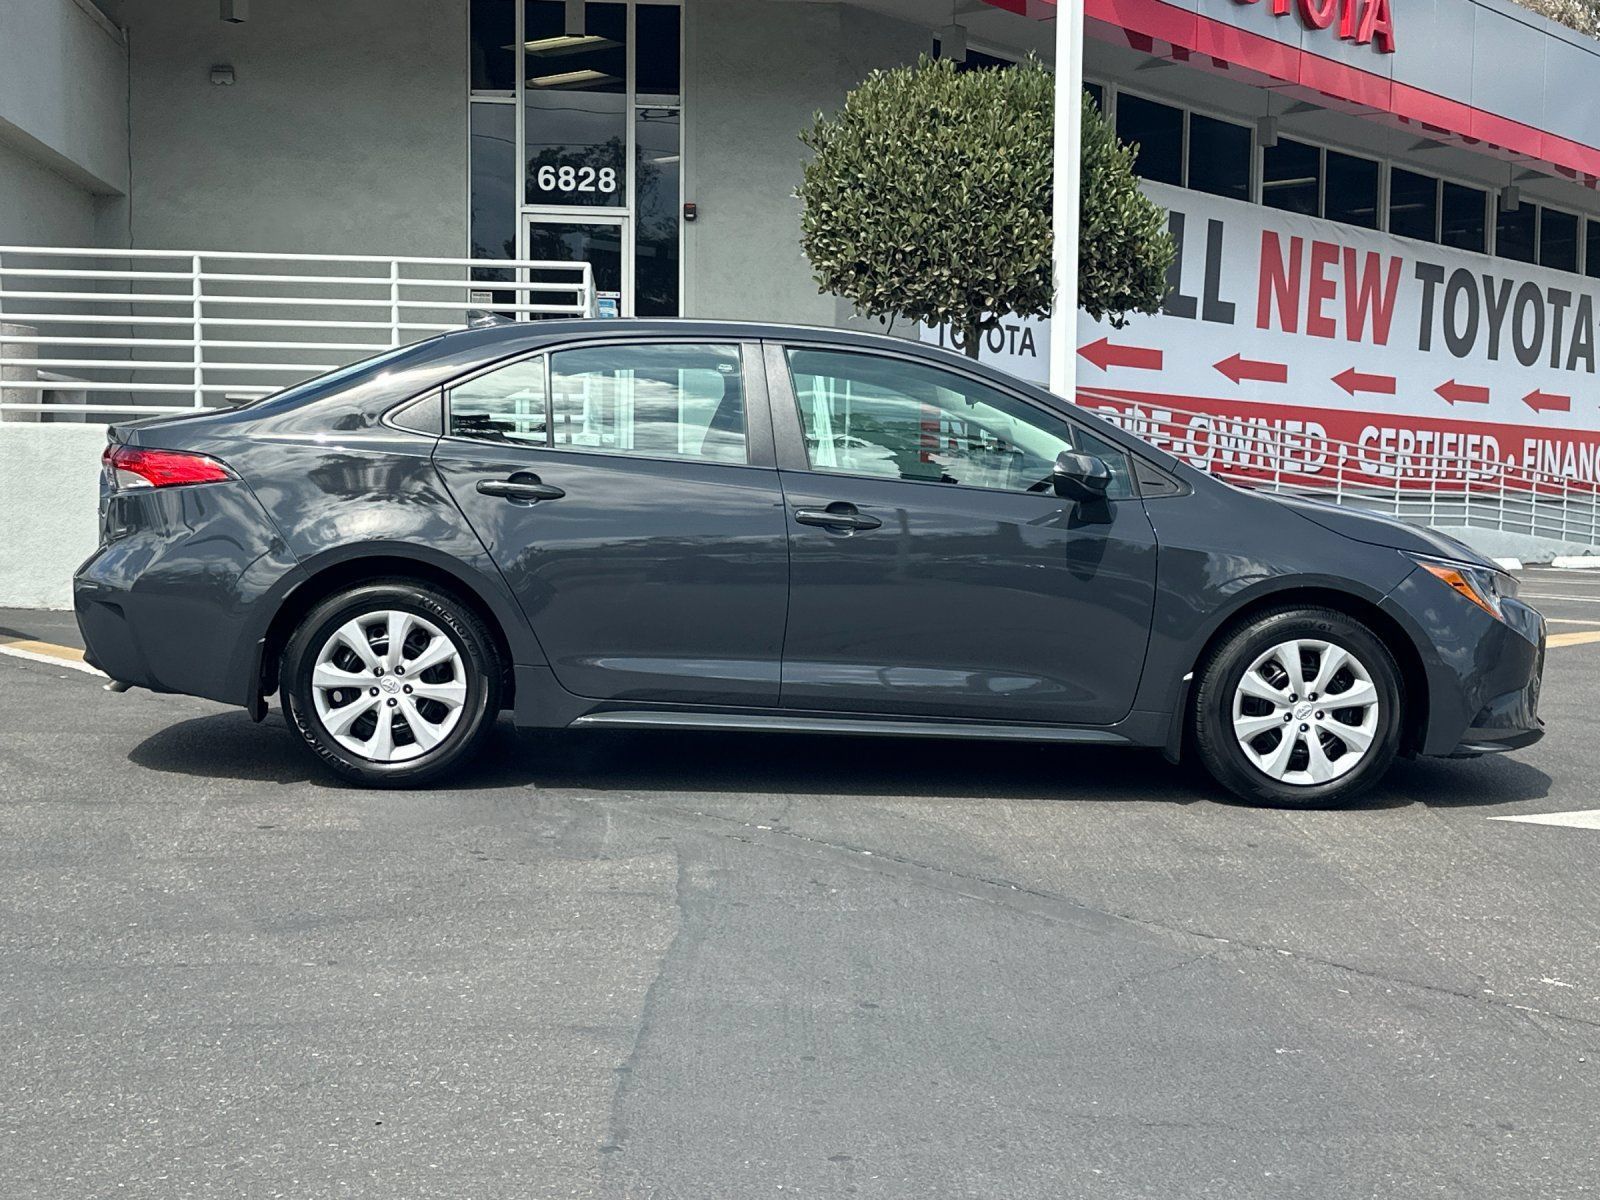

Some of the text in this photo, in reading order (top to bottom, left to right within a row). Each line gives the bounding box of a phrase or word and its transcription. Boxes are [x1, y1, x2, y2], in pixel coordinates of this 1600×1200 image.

[537, 165, 616, 192] 6828
[1162, 210, 1595, 373] LL NEW TOYOTA
[936, 320, 1037, 357] TOOTA
[1357, 425, 1500, 481] CERTIFIED
